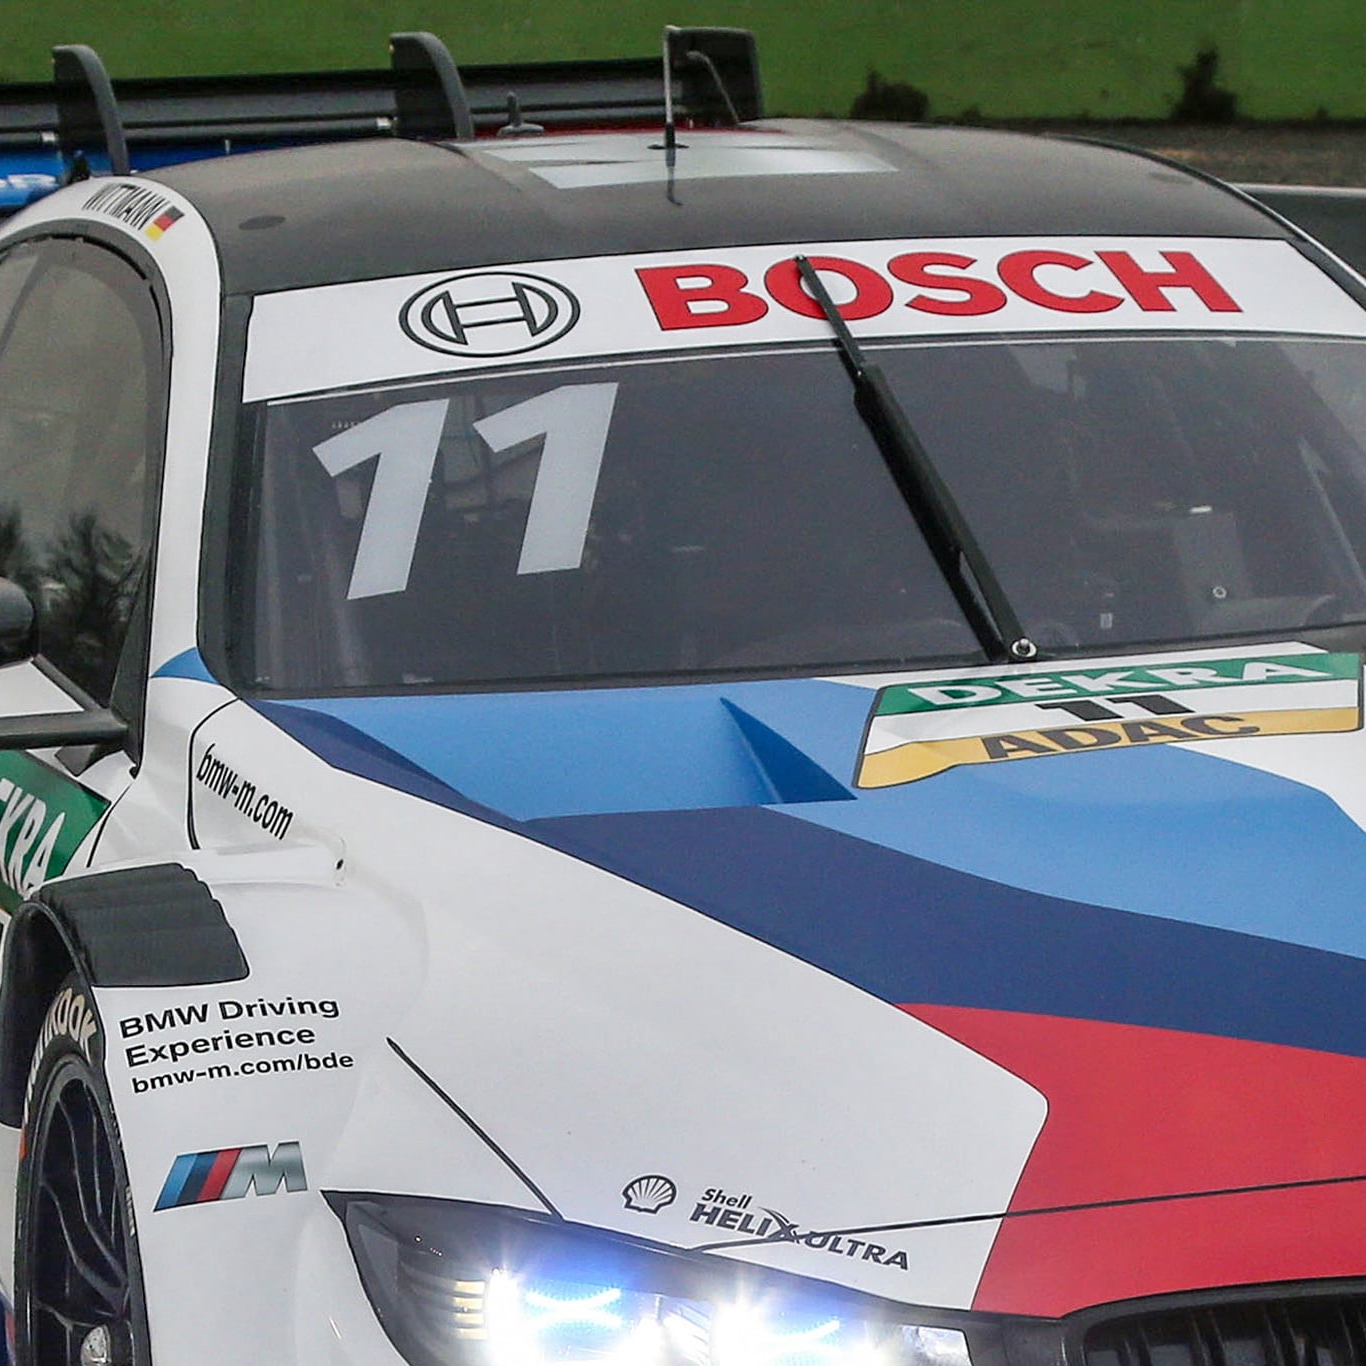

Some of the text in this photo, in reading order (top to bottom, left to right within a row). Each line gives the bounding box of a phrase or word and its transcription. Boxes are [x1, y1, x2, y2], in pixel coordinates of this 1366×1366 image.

[635, 250, 1244, 332] BOSCH
[312, 382, 619, 600] 11
[906, 659, 1334, 706] DEKRA
[1039, 694, 1178, 722] 11
[980, 714, 1262, 760] ADAC
[196, 743, 294, 841] bmw-m.com
[119, 996, 341, 1039] BMW Driving
[125, 1028, 317, 1068] Experience
[131, 1051, 355, 1095] bmw-m.com/bde
[701, 1187, 753, 1210] Shell
[689, 1203, 909, 1271] HELIX ULTRA
